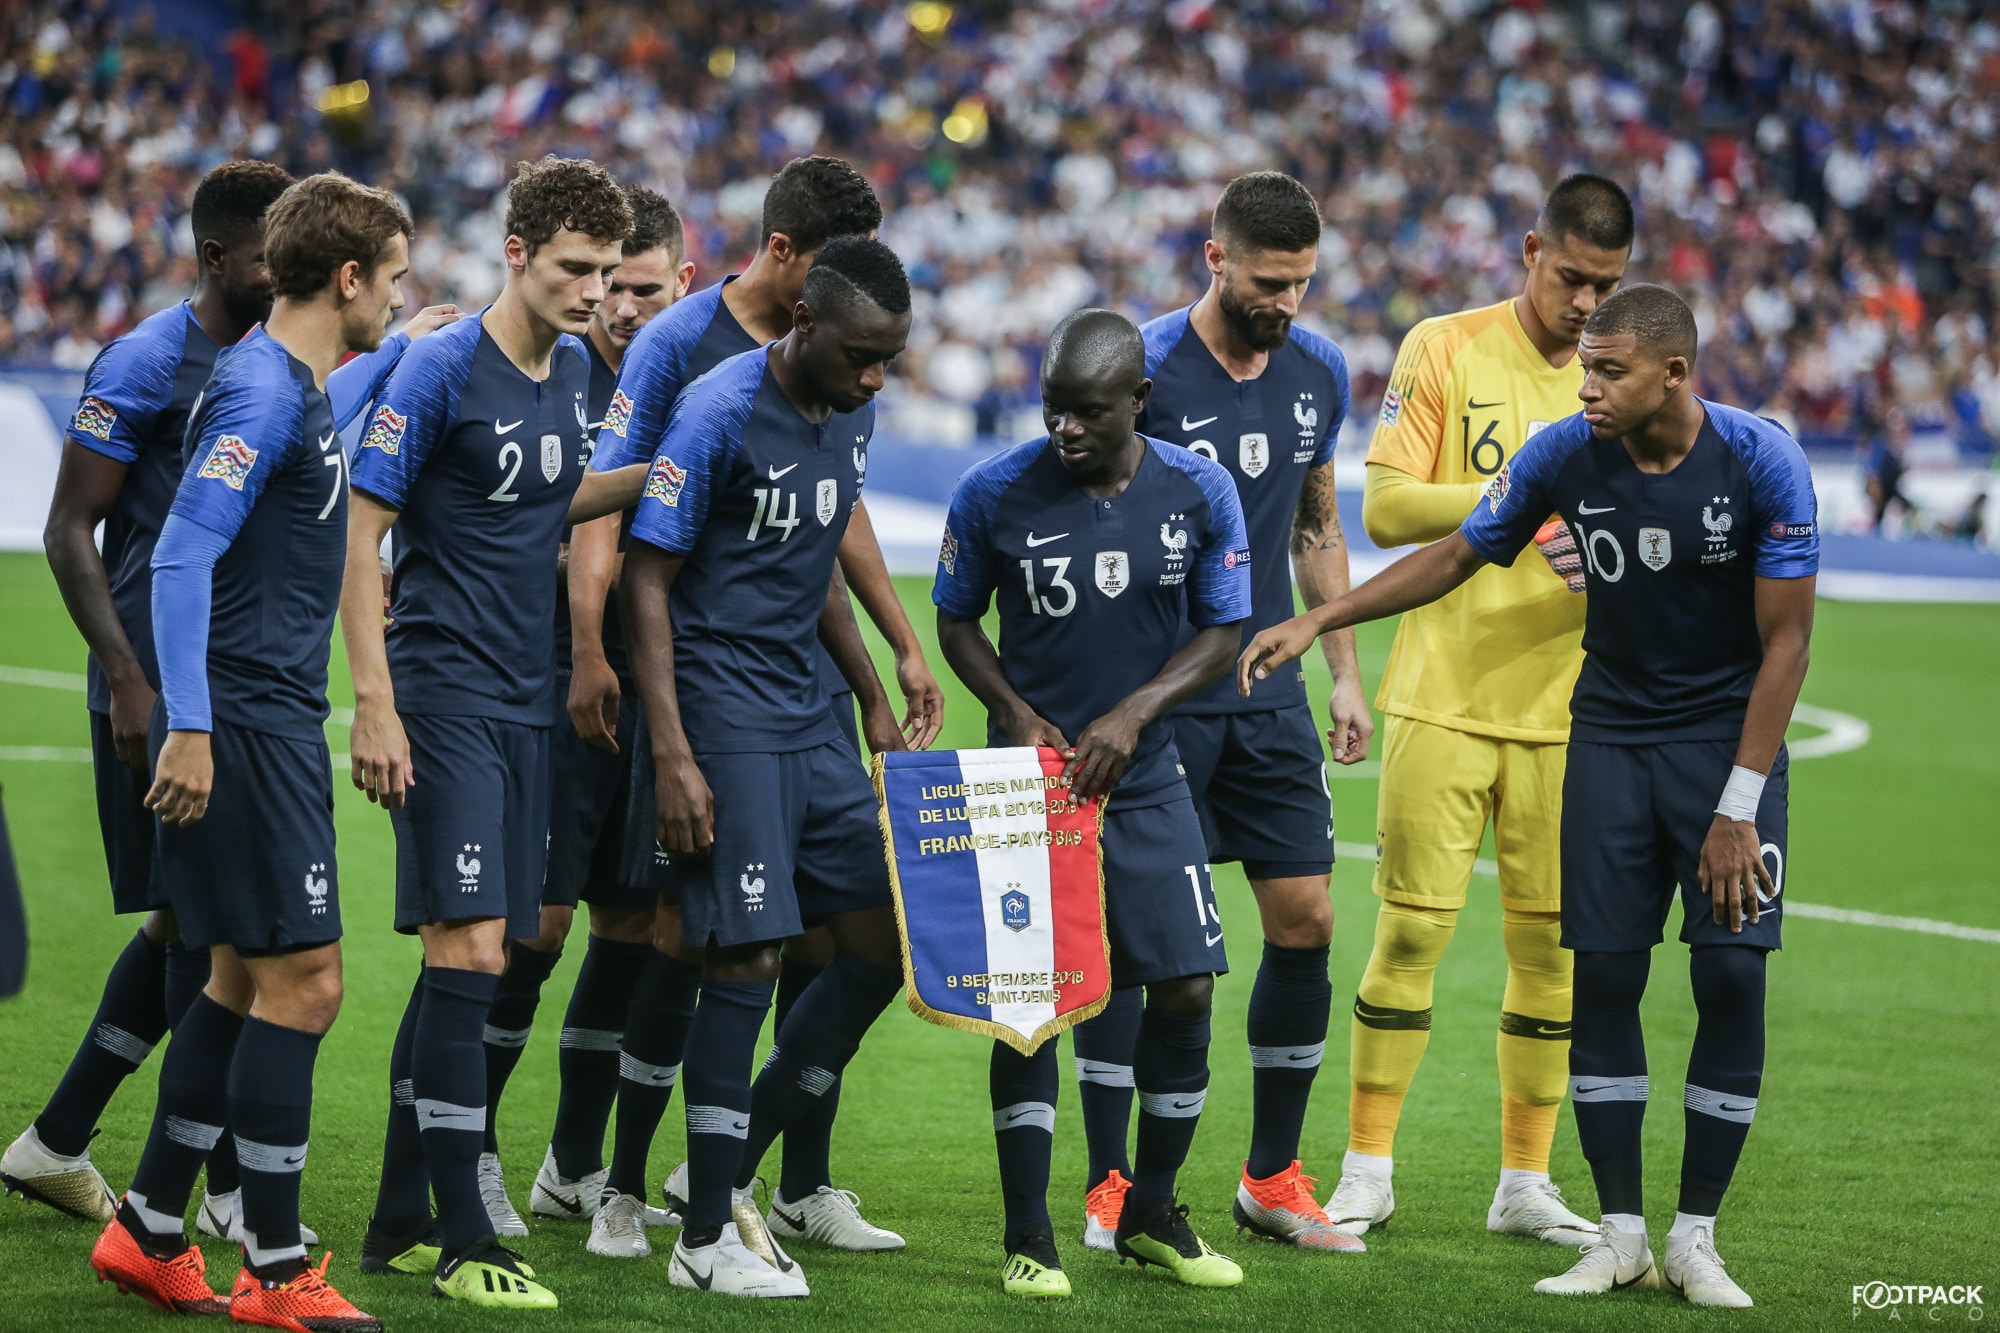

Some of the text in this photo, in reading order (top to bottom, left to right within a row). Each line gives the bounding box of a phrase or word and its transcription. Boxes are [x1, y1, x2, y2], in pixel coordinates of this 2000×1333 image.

[487, 442, 523, 502] 2
[1462, 415, 1505, 475] 16
[318, 453, 342, 520] 7
[746, 488, 800, 542] 14
[1574, 522, 1625, 583] 10
[1020, 556, 1077, 617] 13
[918, 809, 944, 824] DE
[946, 805, 1001, 822] L'UEFA
[921, 775, 1073, 801] LIGUE DES NATIOS
[946, 970, 1085, 988] 9 SEPTEMBRE 2018
[975, 989, 1061, 1005] SAINT-DENIS
